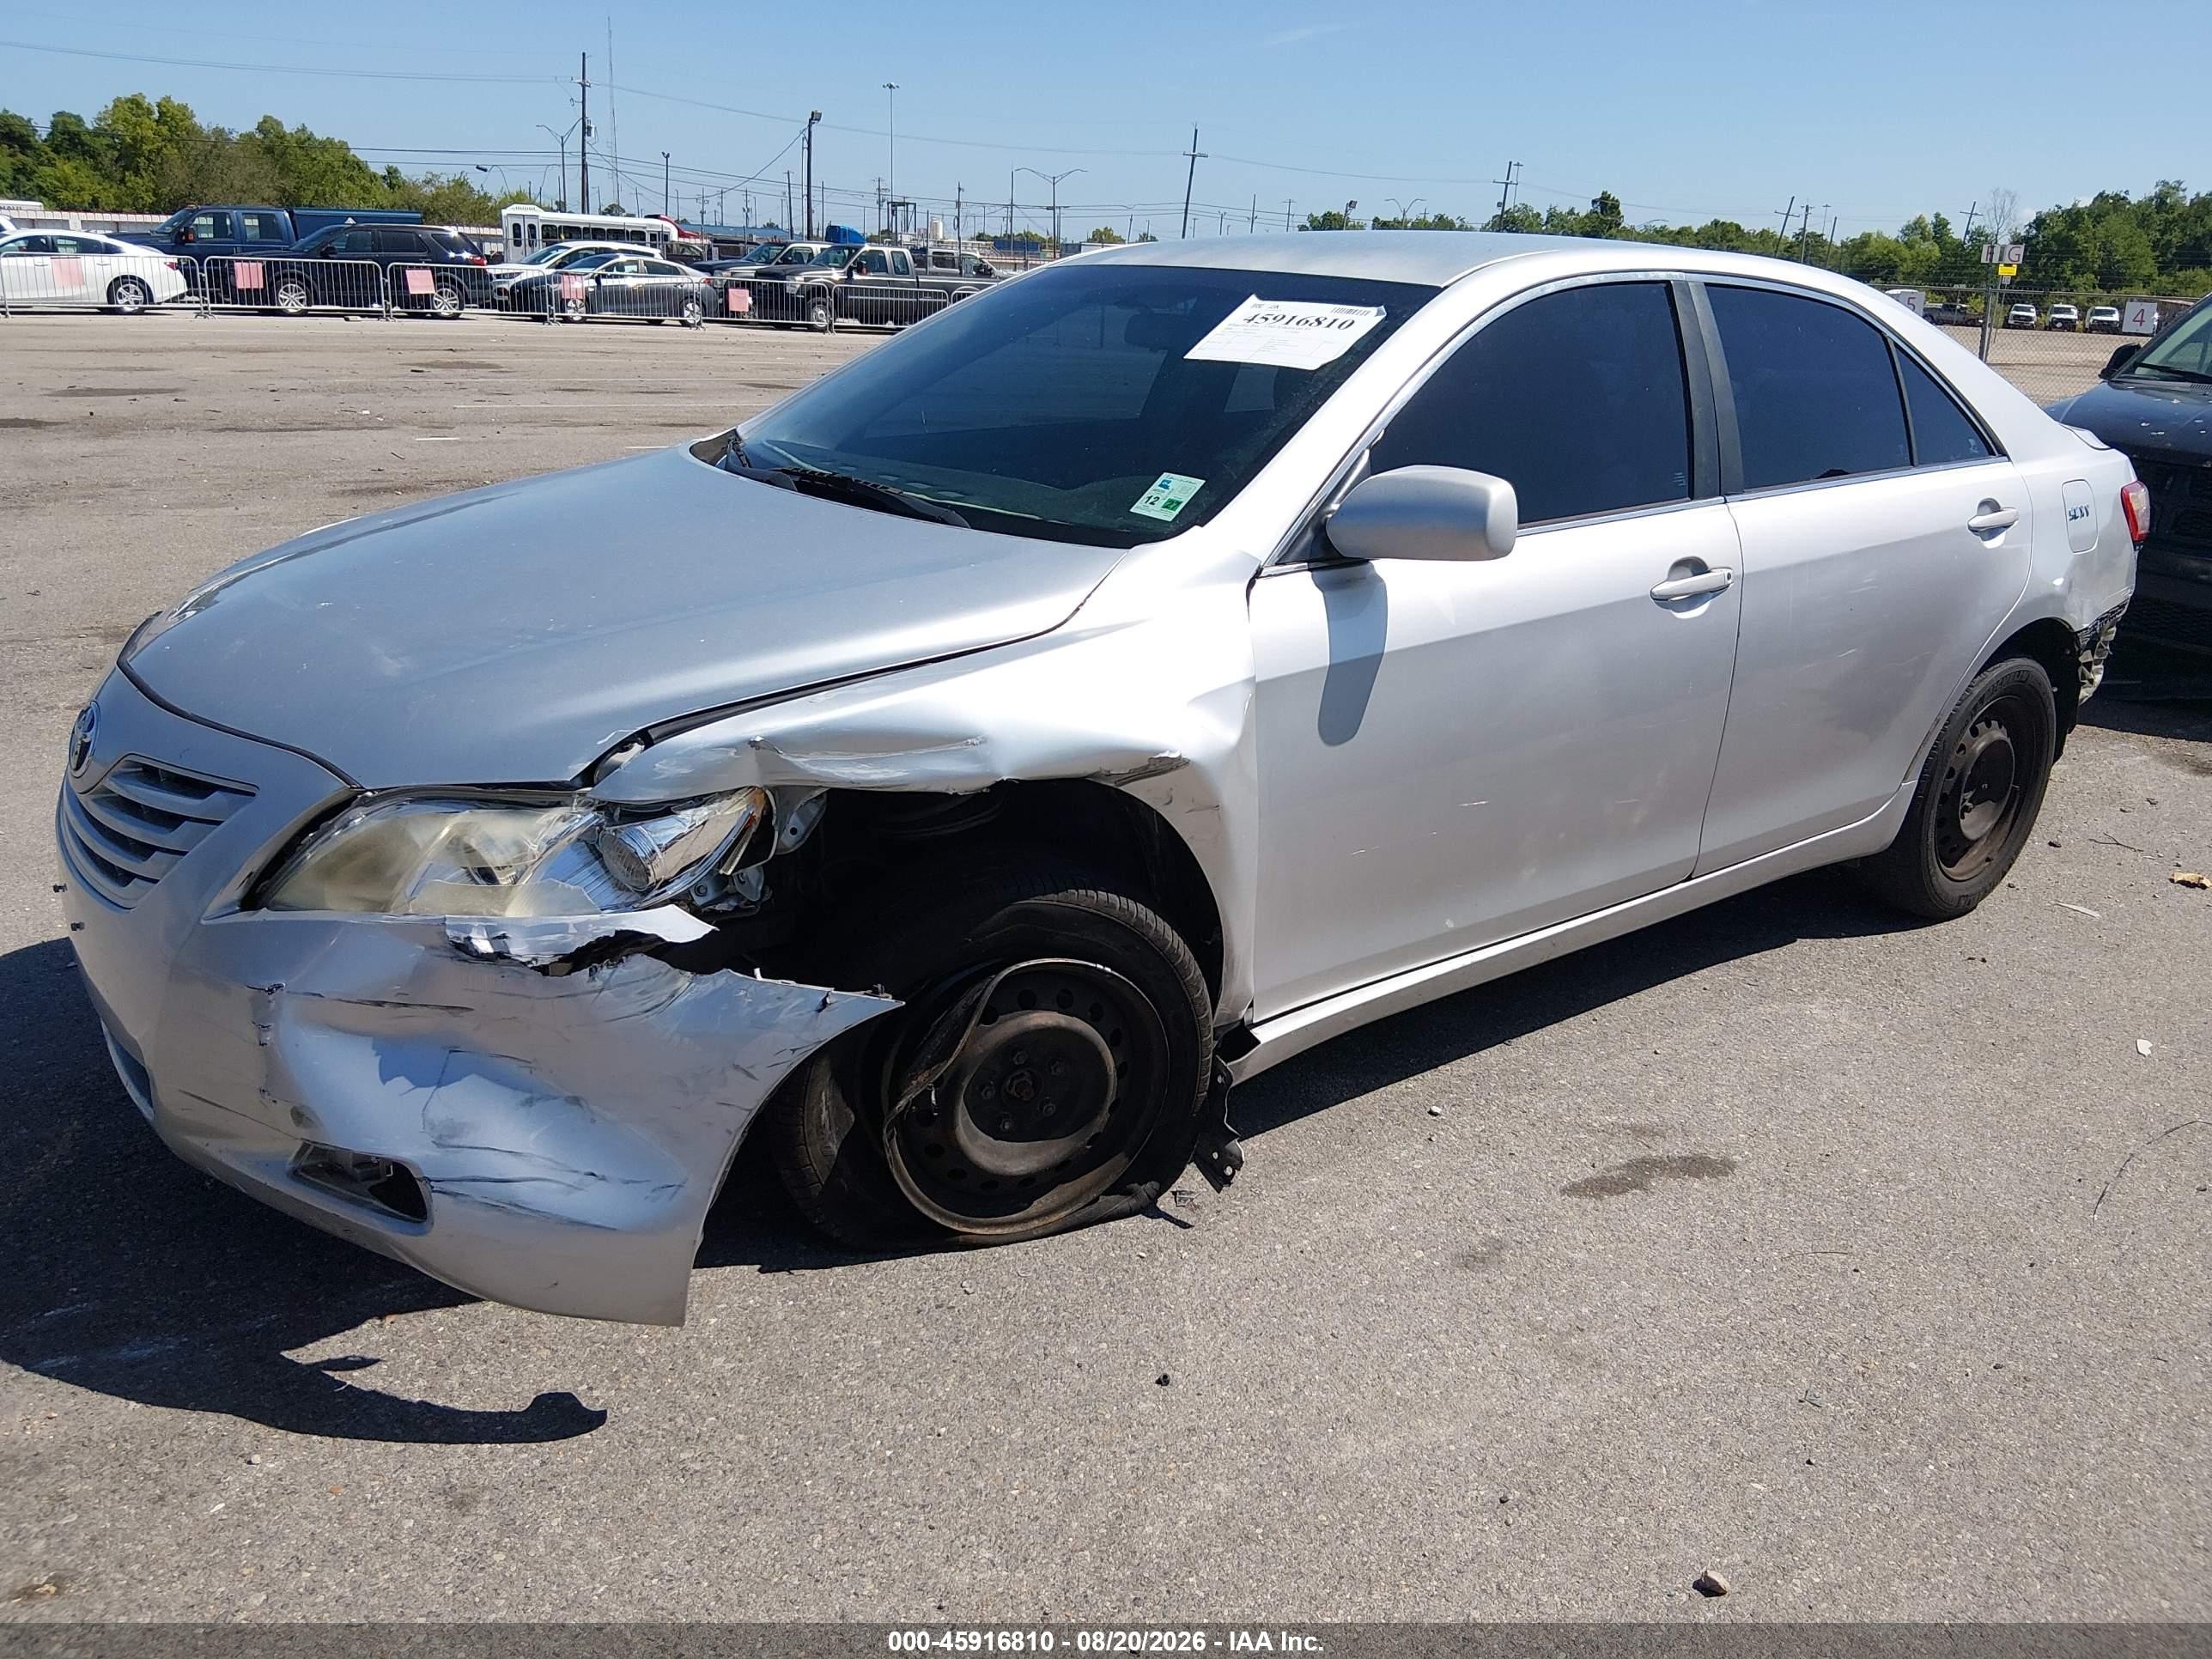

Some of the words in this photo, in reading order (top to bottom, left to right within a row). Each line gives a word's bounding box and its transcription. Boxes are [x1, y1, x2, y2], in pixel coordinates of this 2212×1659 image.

[2008, 246, 2021, 263] G
[1906, 296, 1917, 312] 5
[1243, 313, 1355, 331] 45916810
[2132, 308, 2146, 327] 4
[1144, 495, 1160, 506] 12
